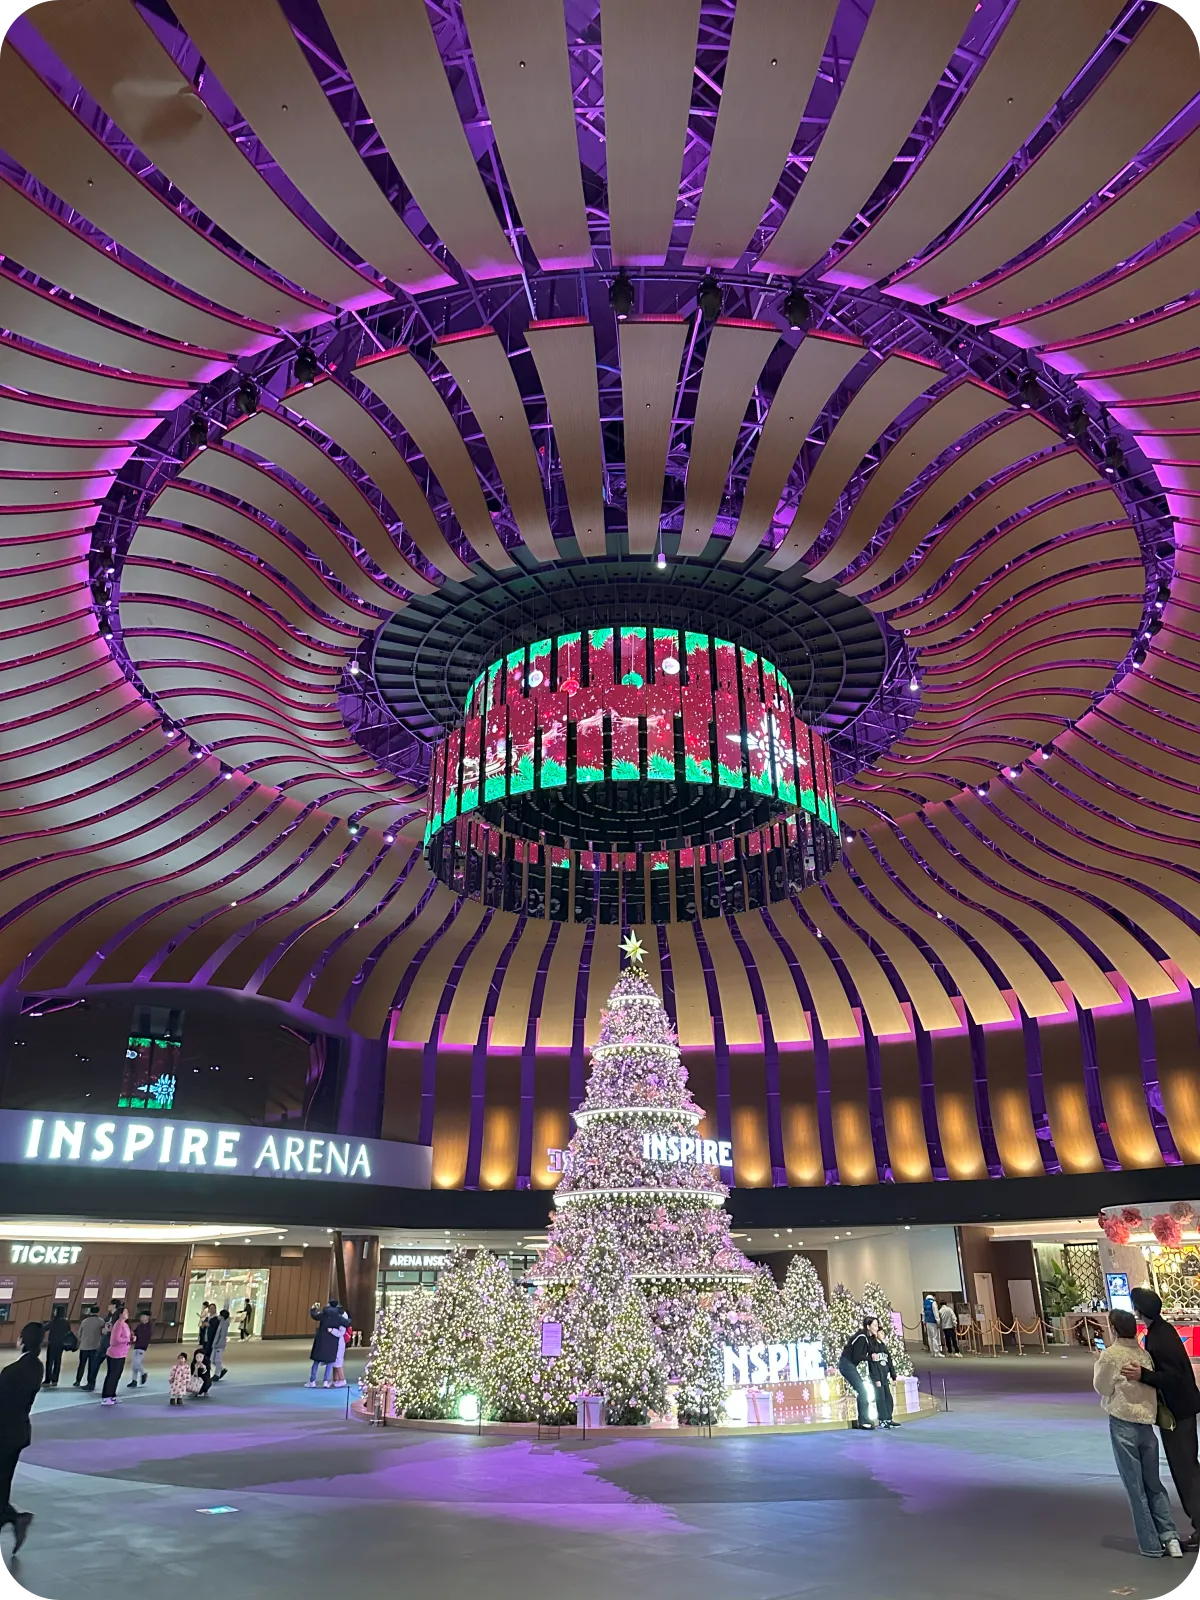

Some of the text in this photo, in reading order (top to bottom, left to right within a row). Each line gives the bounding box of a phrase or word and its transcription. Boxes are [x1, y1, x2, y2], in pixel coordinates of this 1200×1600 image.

[24, 1118, 372, 1178] INSPIRE ARENA
[642, 1133, 733, 1168] INSPIRE
[11, 1244, 83, 1264] TICKET
[389, 1254, 422, 1266] ARENA
[723, 1340, 825, 1386] NSPIRE
